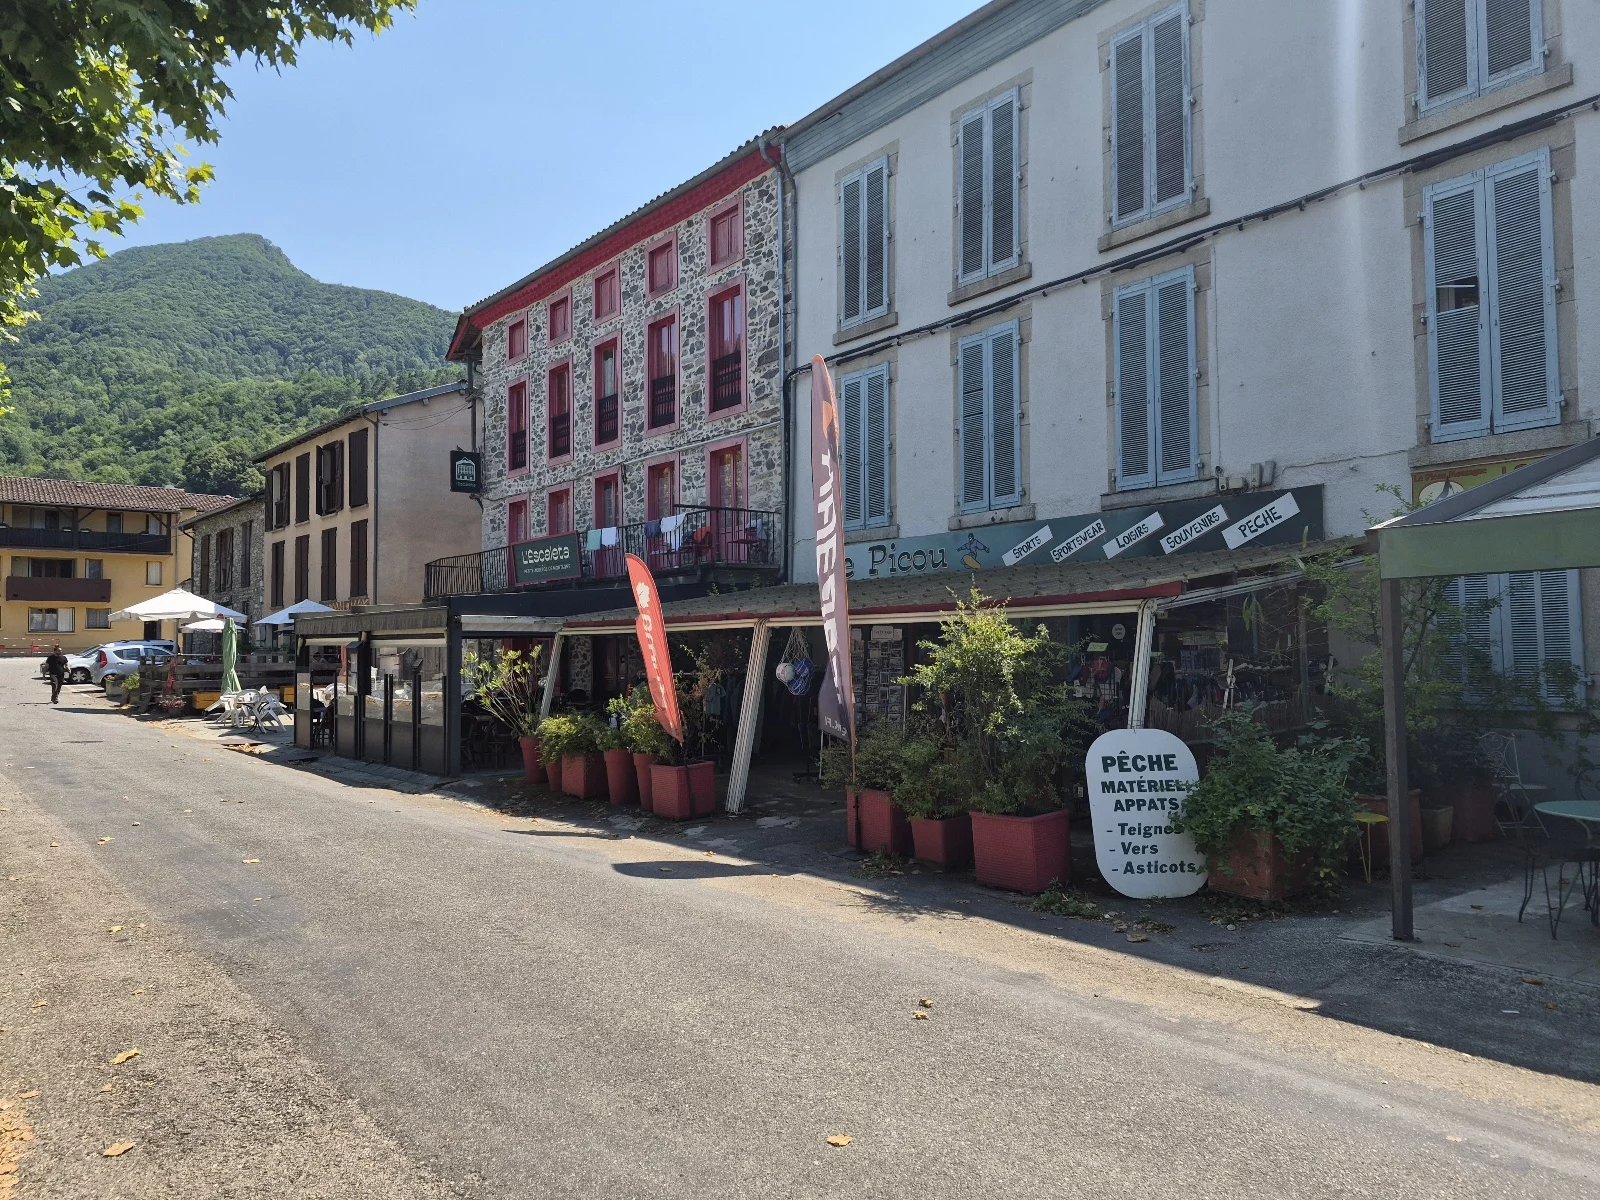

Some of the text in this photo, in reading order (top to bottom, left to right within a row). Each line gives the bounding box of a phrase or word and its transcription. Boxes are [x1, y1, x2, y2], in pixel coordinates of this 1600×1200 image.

[1166, 511, 1220, 549] SOUVENIRS
[1238, 506, 1282, 538] PECHE
[1013, 535, 1042, 559] SPORTS
[1052, 522, 1104, 561] SPORTSWEAR
[1115, 523, 1149, 549] LOISIRS
[868, 542, 948, 576] Picou
[1101, 750, 1178, 773] PÊCHE
[1101, 776, 1185, 793] MATÉRIEL
[1114, 797, 1180, 812] APPATS
[1121, 841, 1159, 855] Vers
[1123, 860, 1196, 875] Asticots
